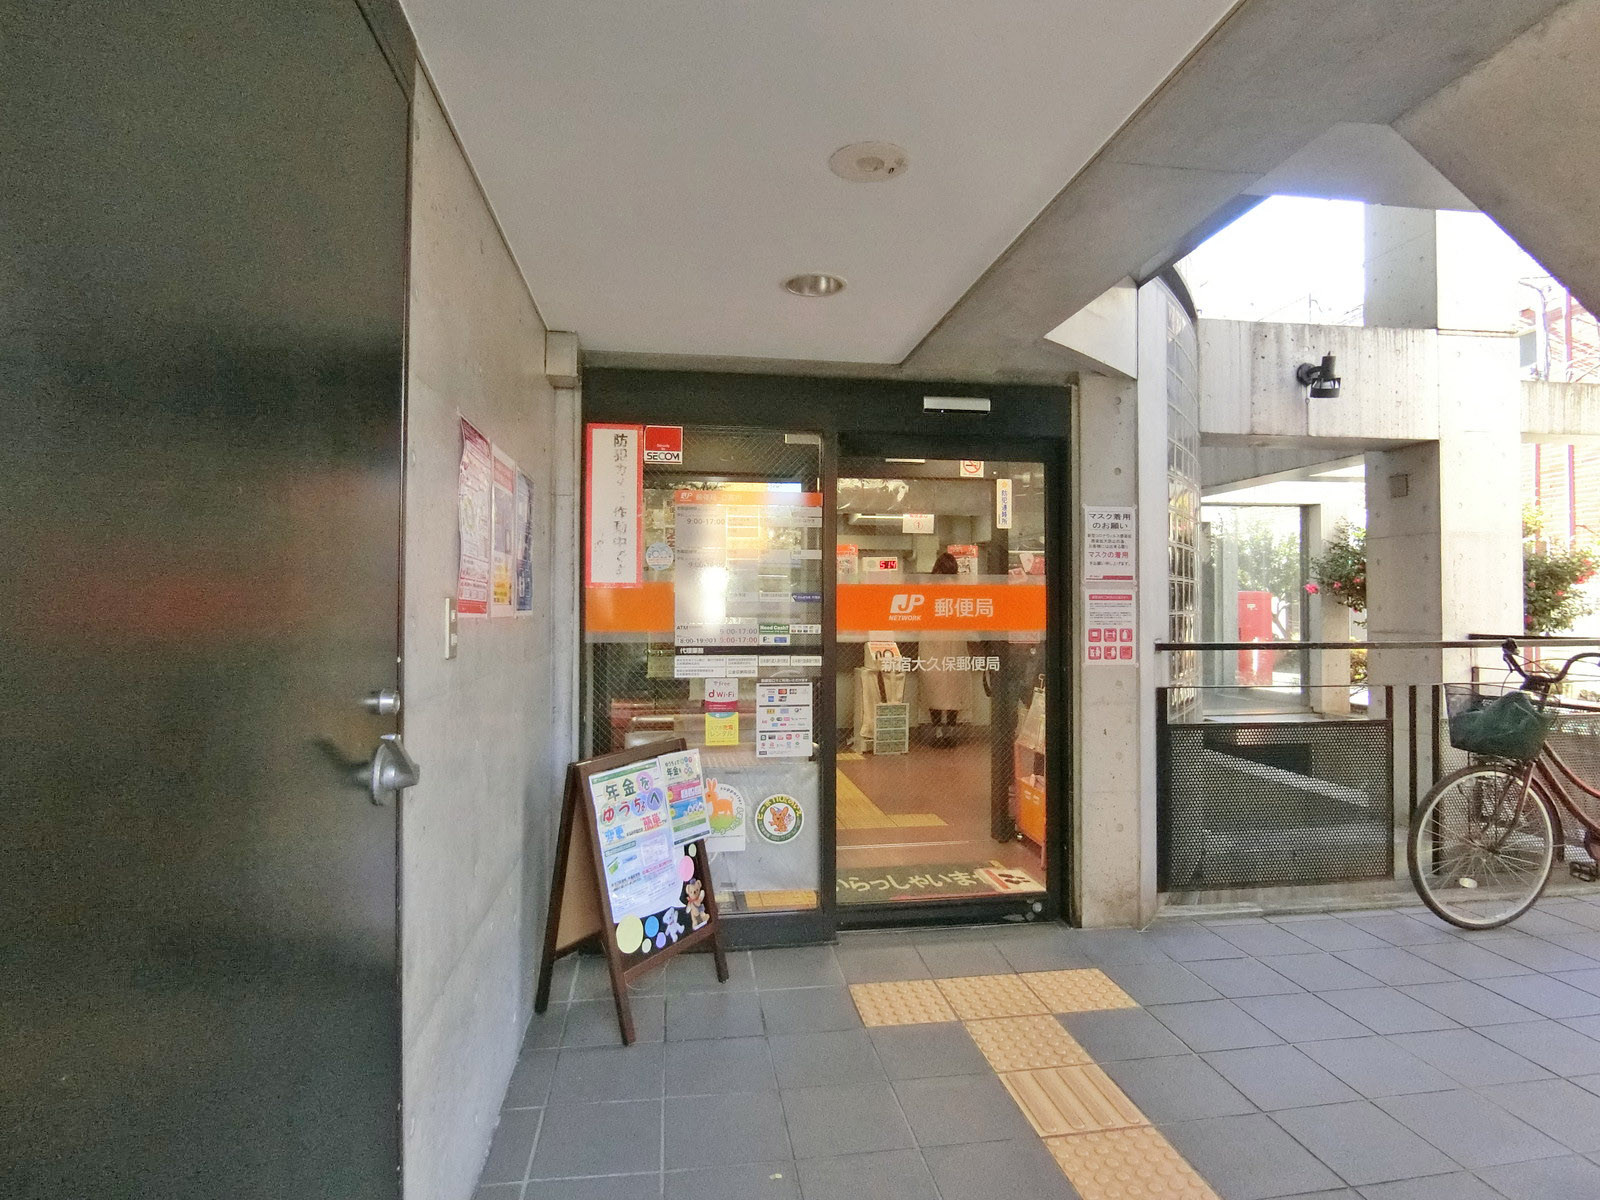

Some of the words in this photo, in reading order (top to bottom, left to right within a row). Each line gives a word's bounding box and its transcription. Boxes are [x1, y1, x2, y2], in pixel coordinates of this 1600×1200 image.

[646, 451, 680, 461] SECOM
[1088, 513, 1131, 521] マスク着用
[1092, 522, 1128, 530] のお願い
[934, 597, 994, 618] 郵便局
[881, 656, 1000, 672] 新宿大久保郵便局
[605, 776, 651, 801] 年金を
[603, 791, 660, 823] ゆうちょへ
